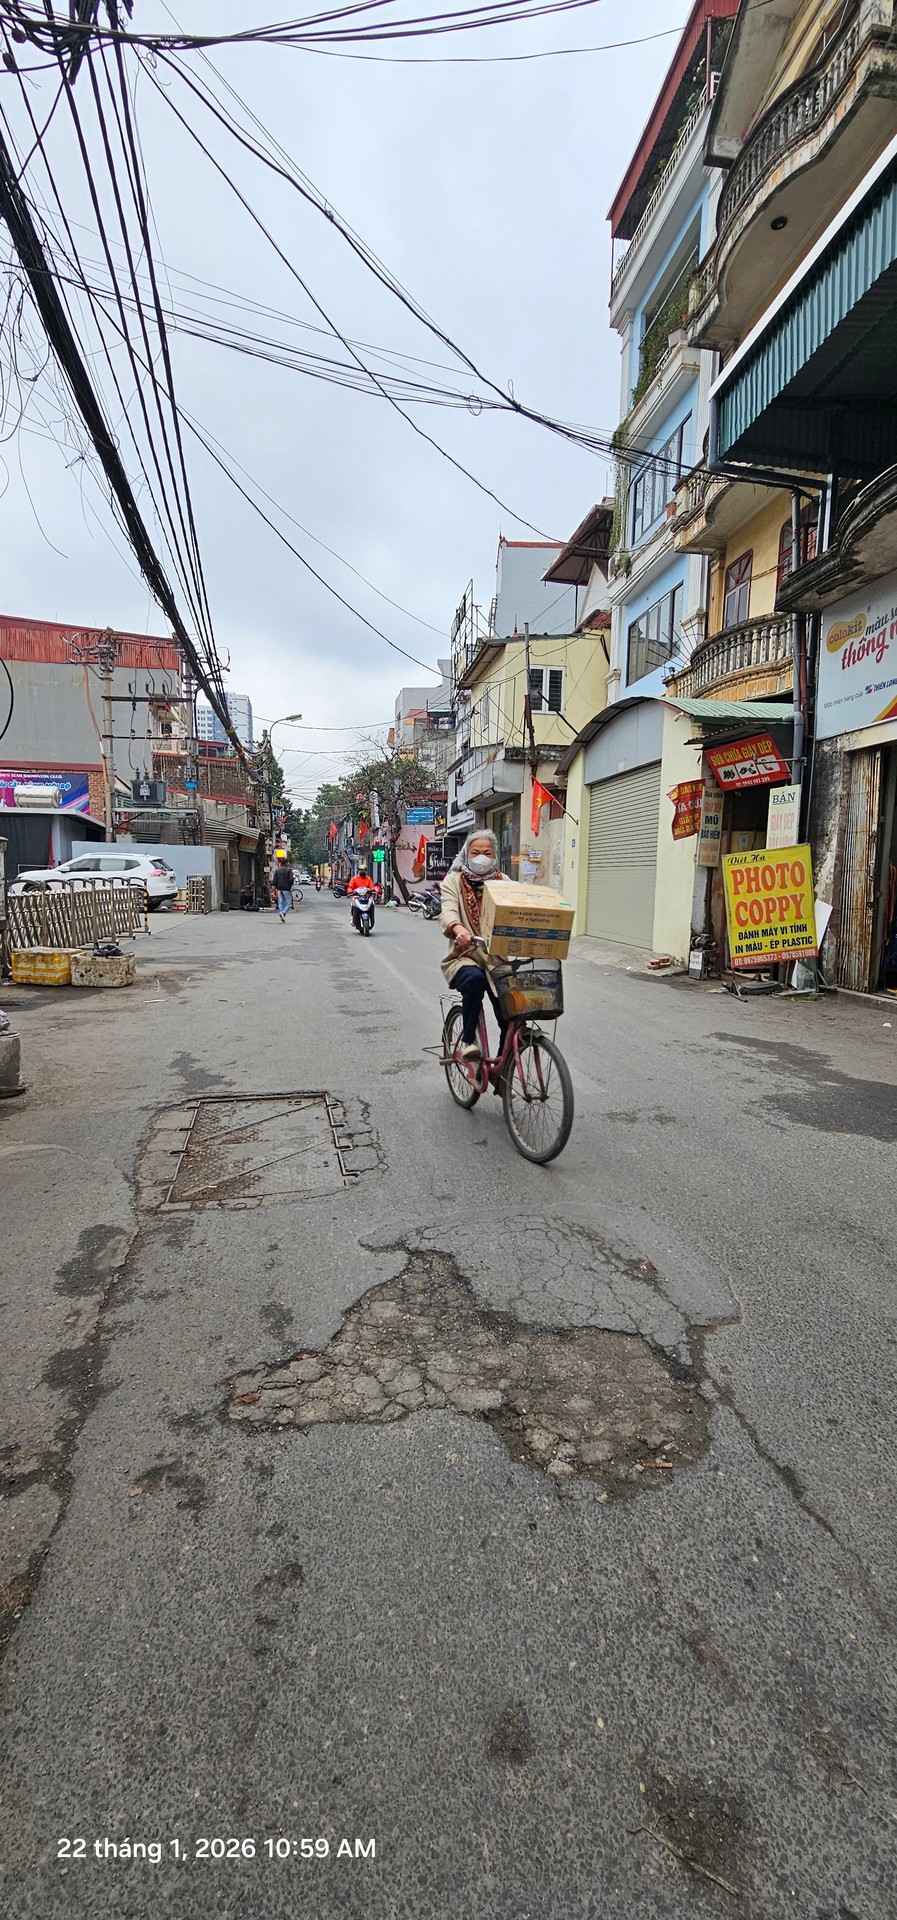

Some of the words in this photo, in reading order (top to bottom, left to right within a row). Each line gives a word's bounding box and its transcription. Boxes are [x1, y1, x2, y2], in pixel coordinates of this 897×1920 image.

[828, 620, 863, 644] colokit
[865, 613, 889, 636] màu
[772, 791, 796, 804] BÁN
[704, 814, 718, 825] MŨ
[731, 860, 805, 896] PHOTO
[734, 893, 805, 927] COPPY
[738, 928, 759, 940] ĐÁNH
[762, 926, 778, 937] MÁY
[780, 926, 788, 935] VI
[790, 922, 807, 934] TÍNH
[735, 945, 743, 954] IN
[746, 940, 762, 952] MÀU
[770, 938, 780, 949] ÉP
[782, 936, 813, 948] PLASTIC
